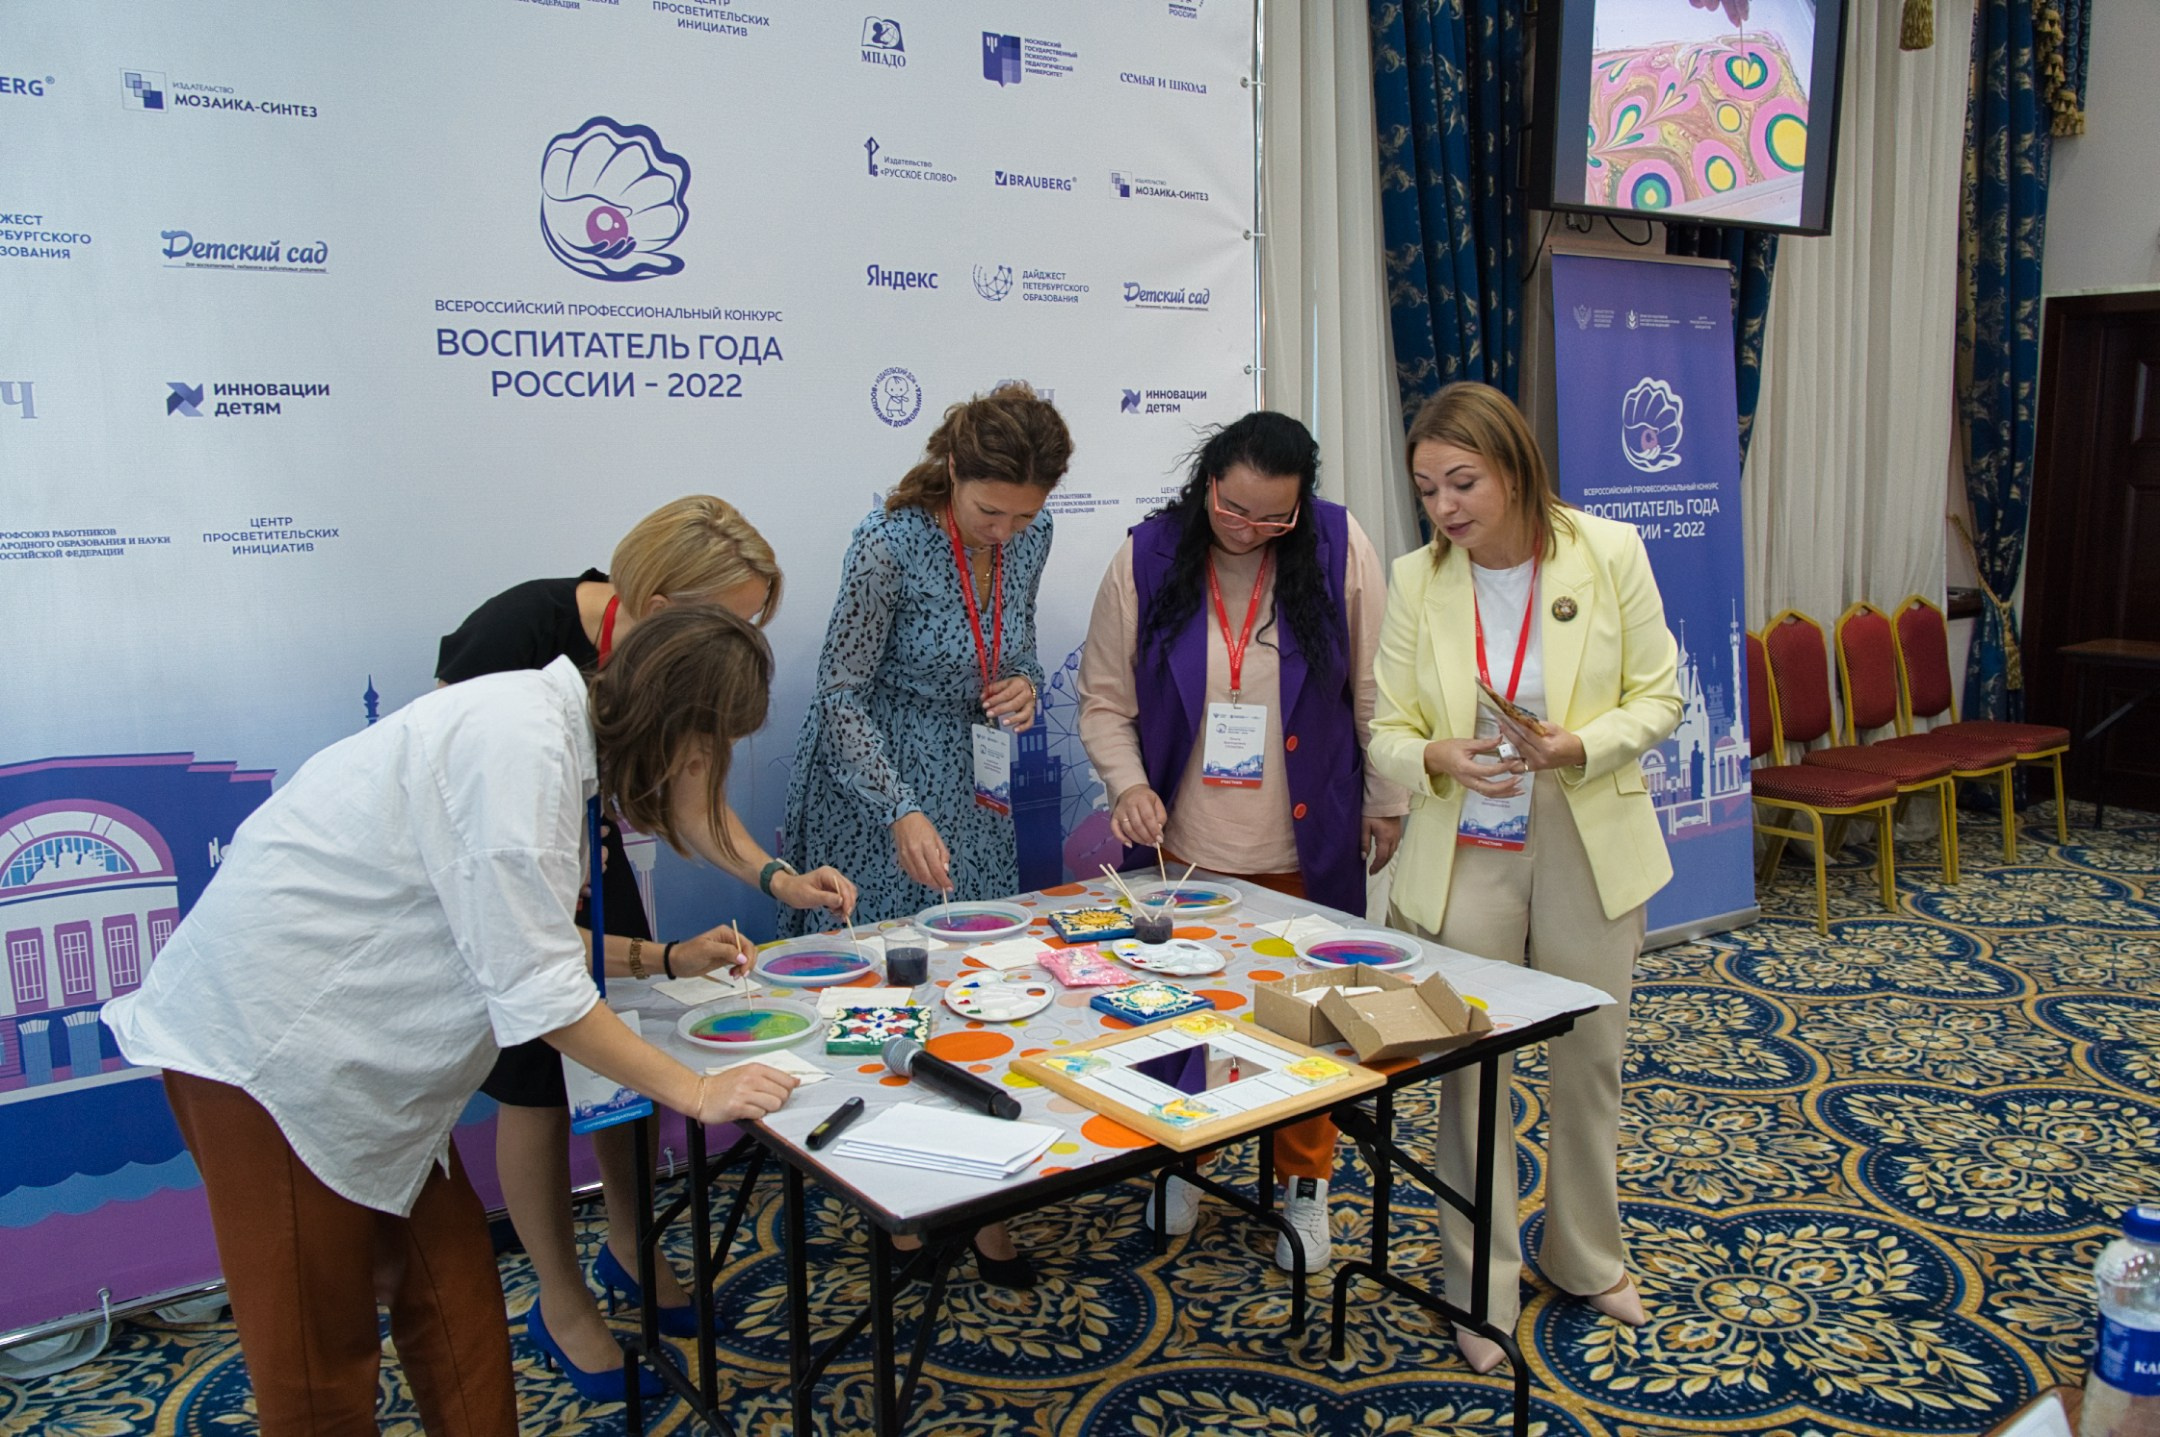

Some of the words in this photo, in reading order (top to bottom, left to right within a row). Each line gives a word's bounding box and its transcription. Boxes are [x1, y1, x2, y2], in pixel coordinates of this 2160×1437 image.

[653, 1, 770, 26] ПРОСВЕТИТЕЛЬСКИХ
[677, 18, 748, 37] ИНИЦИАТИВ
[861, 50, 906, 69] МПАДО
[1120, 72, 1155, 87] семья
[1158, 77, 1166, 88] и
[1169, 79, 1207, 94] школа
[174, 93, 318, 118] МОЗАИКА-СИНТЕЗ
[883, 156, 933, 168] Издательство
[881, 168, 922, 180] «РУССКОЕ
[923, 171, 957, 183] СЛОВО»
[1135, 186, 1209, 201] МОЗАИКА-СИНТЕЗ
[160, 230, 281, 263] Детский
[286, 240, 328, 264] сад
[866, 264, 938, 290] Яндекс
[1022, 268, 1066, 280] ДАЙДЖЕСТ
[1022, 281, 1090, 293] ПЕТЕРБУРГСКОГО
[1123, 282, 1186, 303] Детский
[1188, 288, 1210, 305] сад
[1022, 293, 1079, 303] ОБРАЗОВАНИЯ
[435, 300, 565, 316] ВСЕРОССИЙСКИЙ
[568, 304, 722, 320] ПРОФЕССИОНАЛЬНЫЙ
[724, 309, 783, 322] КОНКУРС
[437, 328, 690, 360] ВОСПИТАТЕЛЬ
[699, 334, 784, 366] ГОДА
[213, 383, 330, 398] инновации
[491, 370, 635, 398] РОССИИ
[667, 372, 743, 398] 2022
[1145, 389, 1207, 401] инновации
[214, 401, 281, 417] детям
[1145, 403, 1181, 414] детям
[1584, 485, 1632, 496] ВСЕРОССИЙСКИЙ
[1633, 482, 1696, 493] ПРОФЕССИОНАЛЬНЫЙ
[1697, 482, 1719, 490] КОНКУРС
[1687, 498, 1720, 516] ГОДА
[250, 517, 293, 528] ЦЕНТР
[1673, 521, 1705, 538] 2022
[52, 528, 117, 539] РАБОТНИКОВ
[203, 529, 340, 543] ПРОСВЕТИТЕЛЬСКИХ
[56, 537, 126, 549] ОБРАЗОВАНИЯ
[128, 537, 136, 545] И
[138, 536, 171, 545] НАУКИ
[232, 542, 314, 555] ИНИЦИАТИВ
[65, 548, 124, 559] ФЕДЕРАЦИИ
